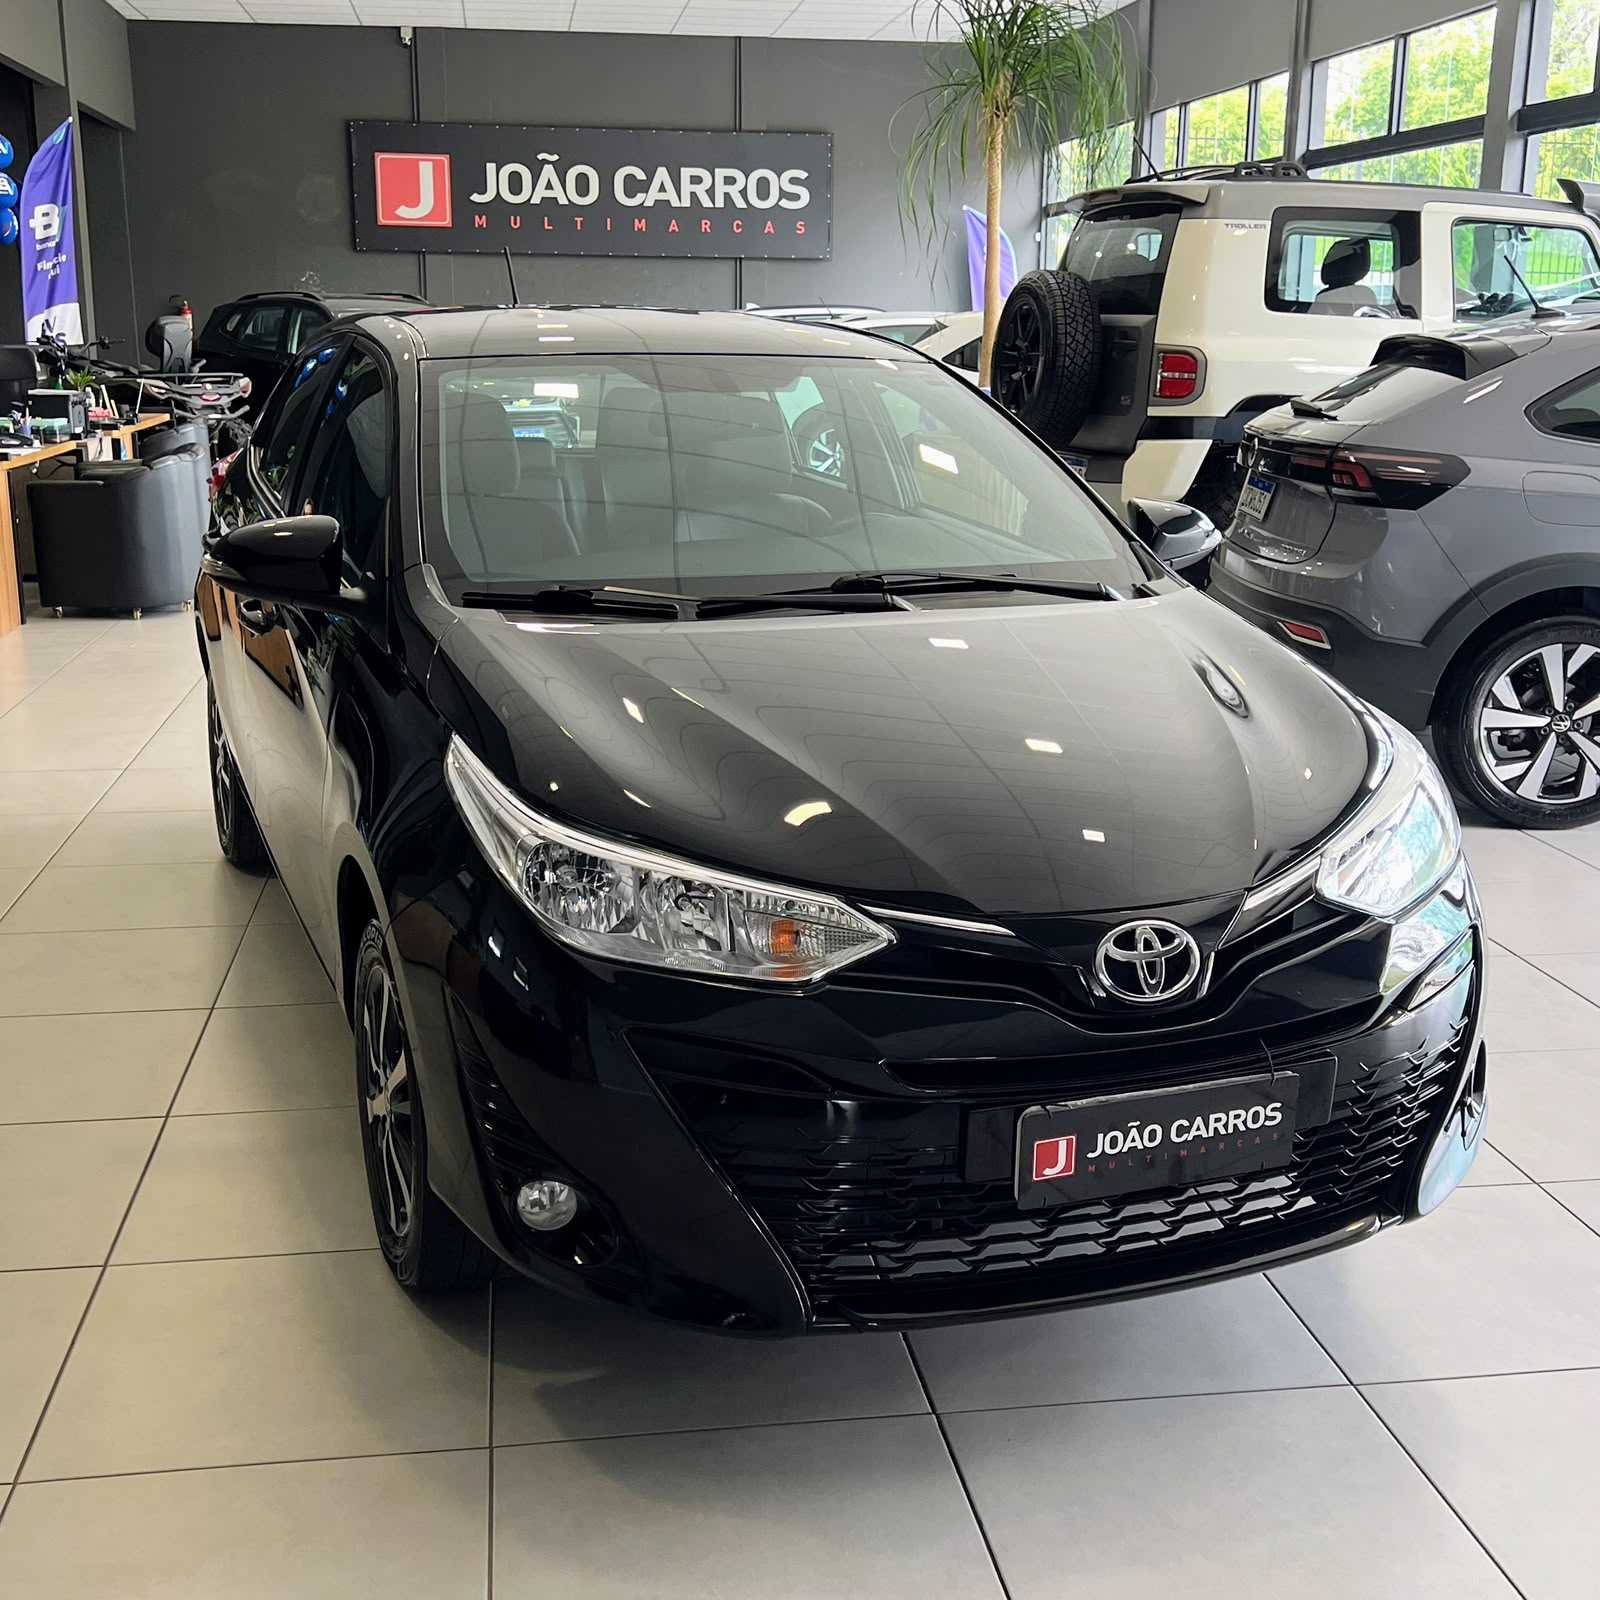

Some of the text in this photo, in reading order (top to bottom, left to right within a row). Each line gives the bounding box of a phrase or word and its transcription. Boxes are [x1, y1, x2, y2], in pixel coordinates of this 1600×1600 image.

[394, 161, 434, 219] J
[469, 152, 811, 210] JOÃO CARROS
[473, 214, 806, 234] MULTIMARCAS
[1086, 1102, 1283, 1159] JOÃO CARROS
[1087, 1131, 1279, 1174] MULTIMARCAS
